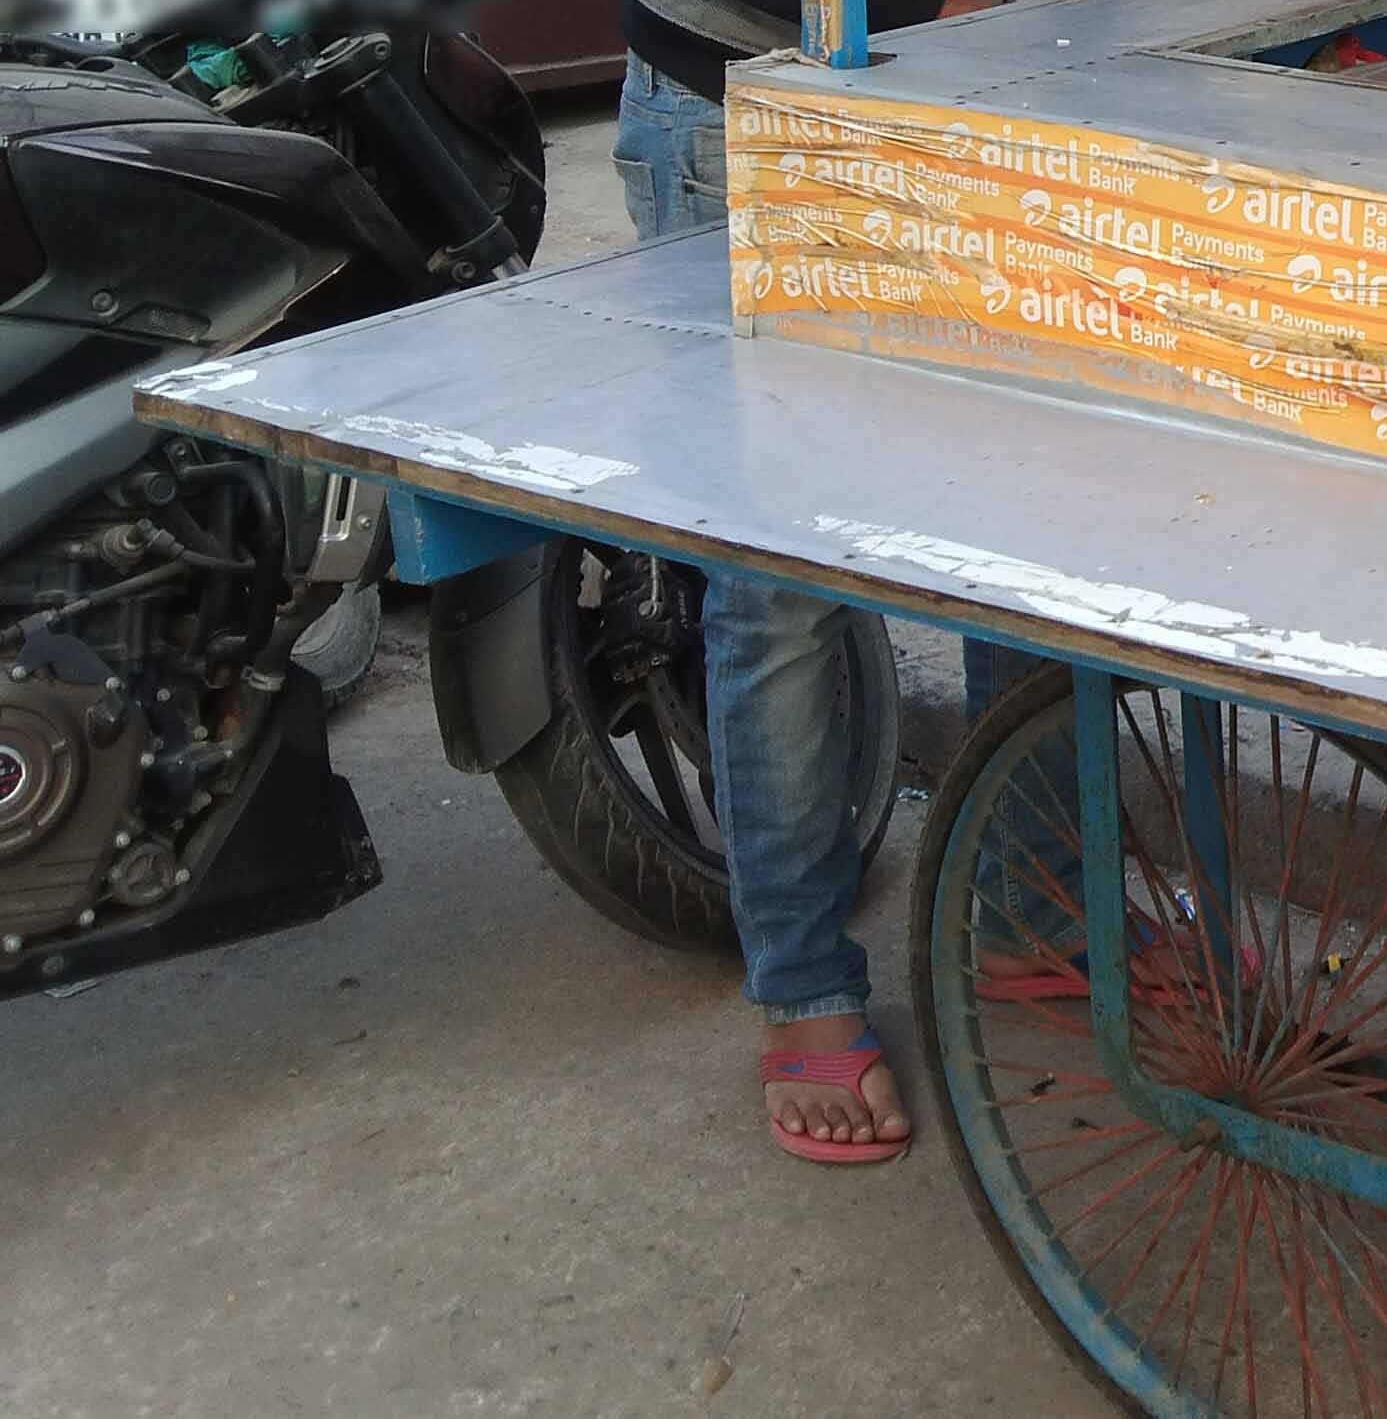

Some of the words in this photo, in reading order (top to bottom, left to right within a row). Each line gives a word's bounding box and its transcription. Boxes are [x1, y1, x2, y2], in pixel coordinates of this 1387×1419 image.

[980, 126, 1082, 184] airtel
[914, 164, 1002, 198] Payments
[1088, 166, 1136, 197] Bank
[1058, 198, 1162, 259] airtel
[1171, 222, 1265, 264] Payments
[1243, 183, 1355, 246] airtel
[900, 217, 996, 264] airtel
[1004, 231, 1095, 273] Payments
[781, 259, 874, 300] airtel
[879, 279, 924, 304] Bank
[1020, 285, 1125, 341] airtel
[1130, 325, 1179, 353] Bank
[1253, 385, 1302, 421] Bank
